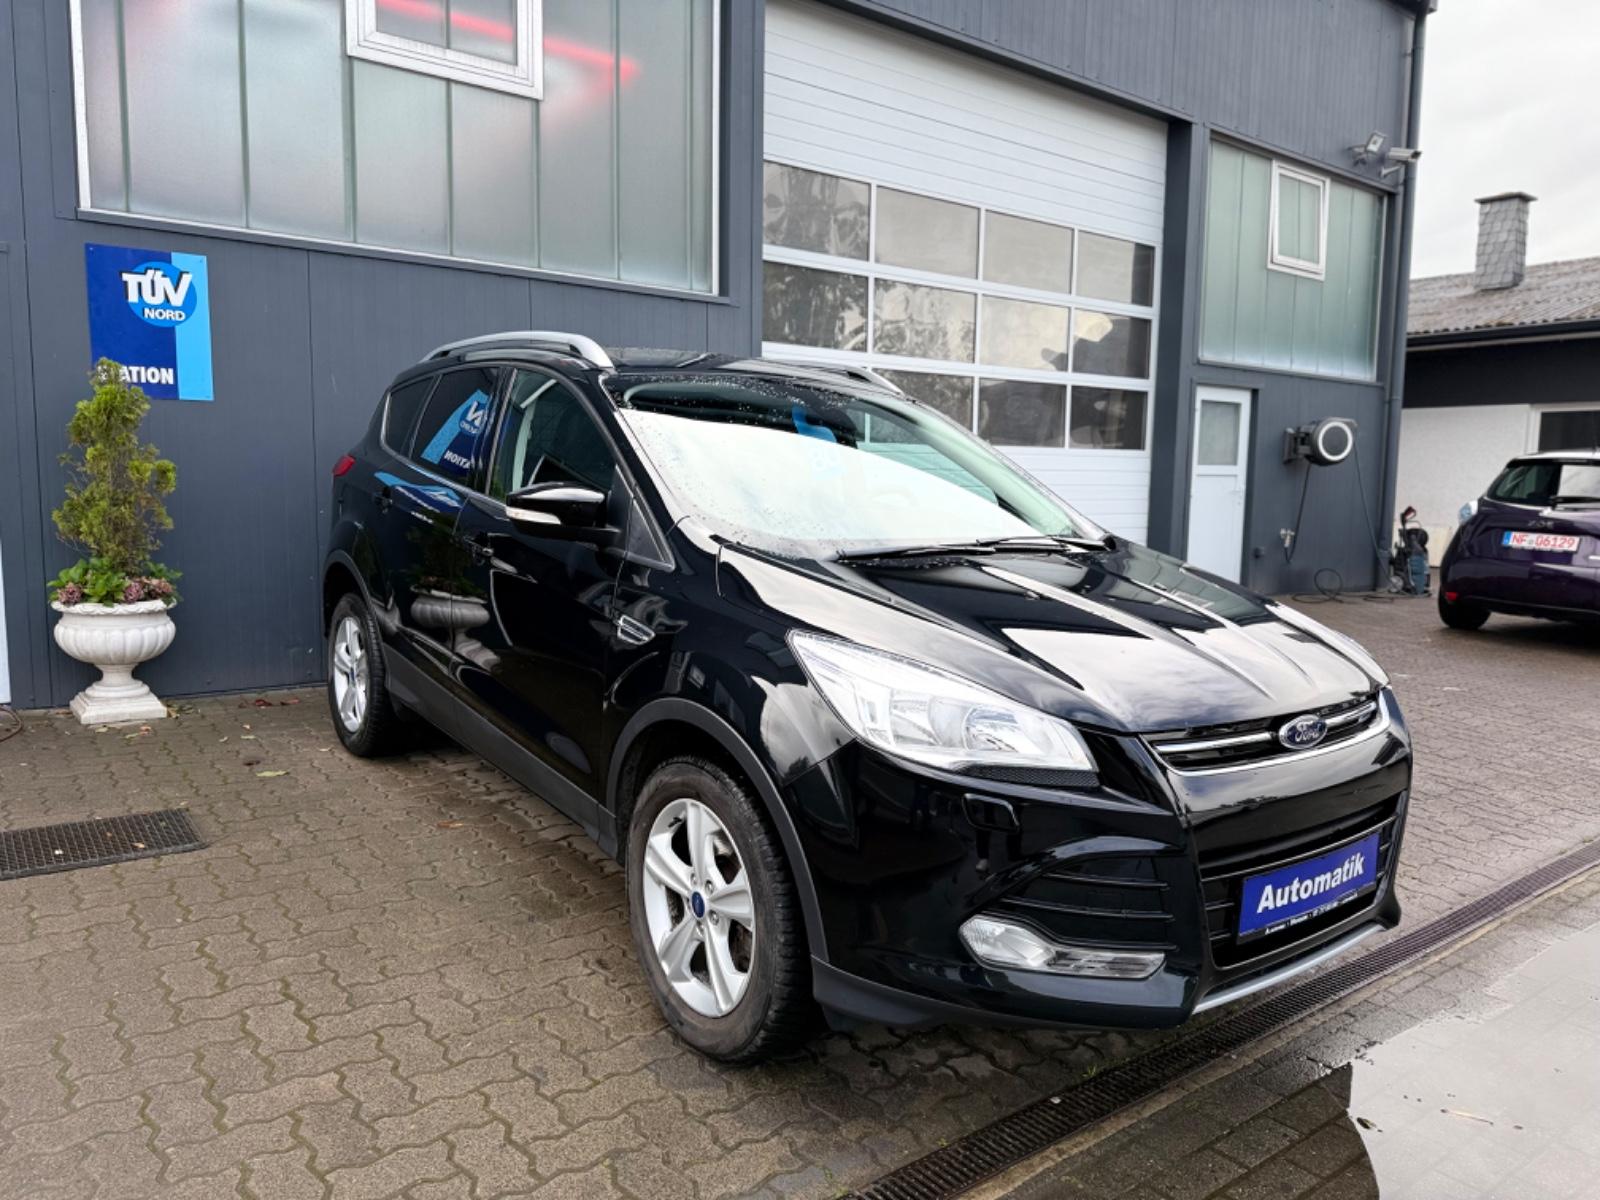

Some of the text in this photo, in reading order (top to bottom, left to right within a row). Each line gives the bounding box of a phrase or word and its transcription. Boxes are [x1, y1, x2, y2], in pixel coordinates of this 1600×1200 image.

[121, 269, 193, 307] TÜV
[144, 308, 186, 321] NORD
[98, 367, 174, 385] ATION
[1512, 534, 1528, 545] NF
[1294, 720, 1320, 742] Ford
[1257, 852, 1365, 913] Automatik
